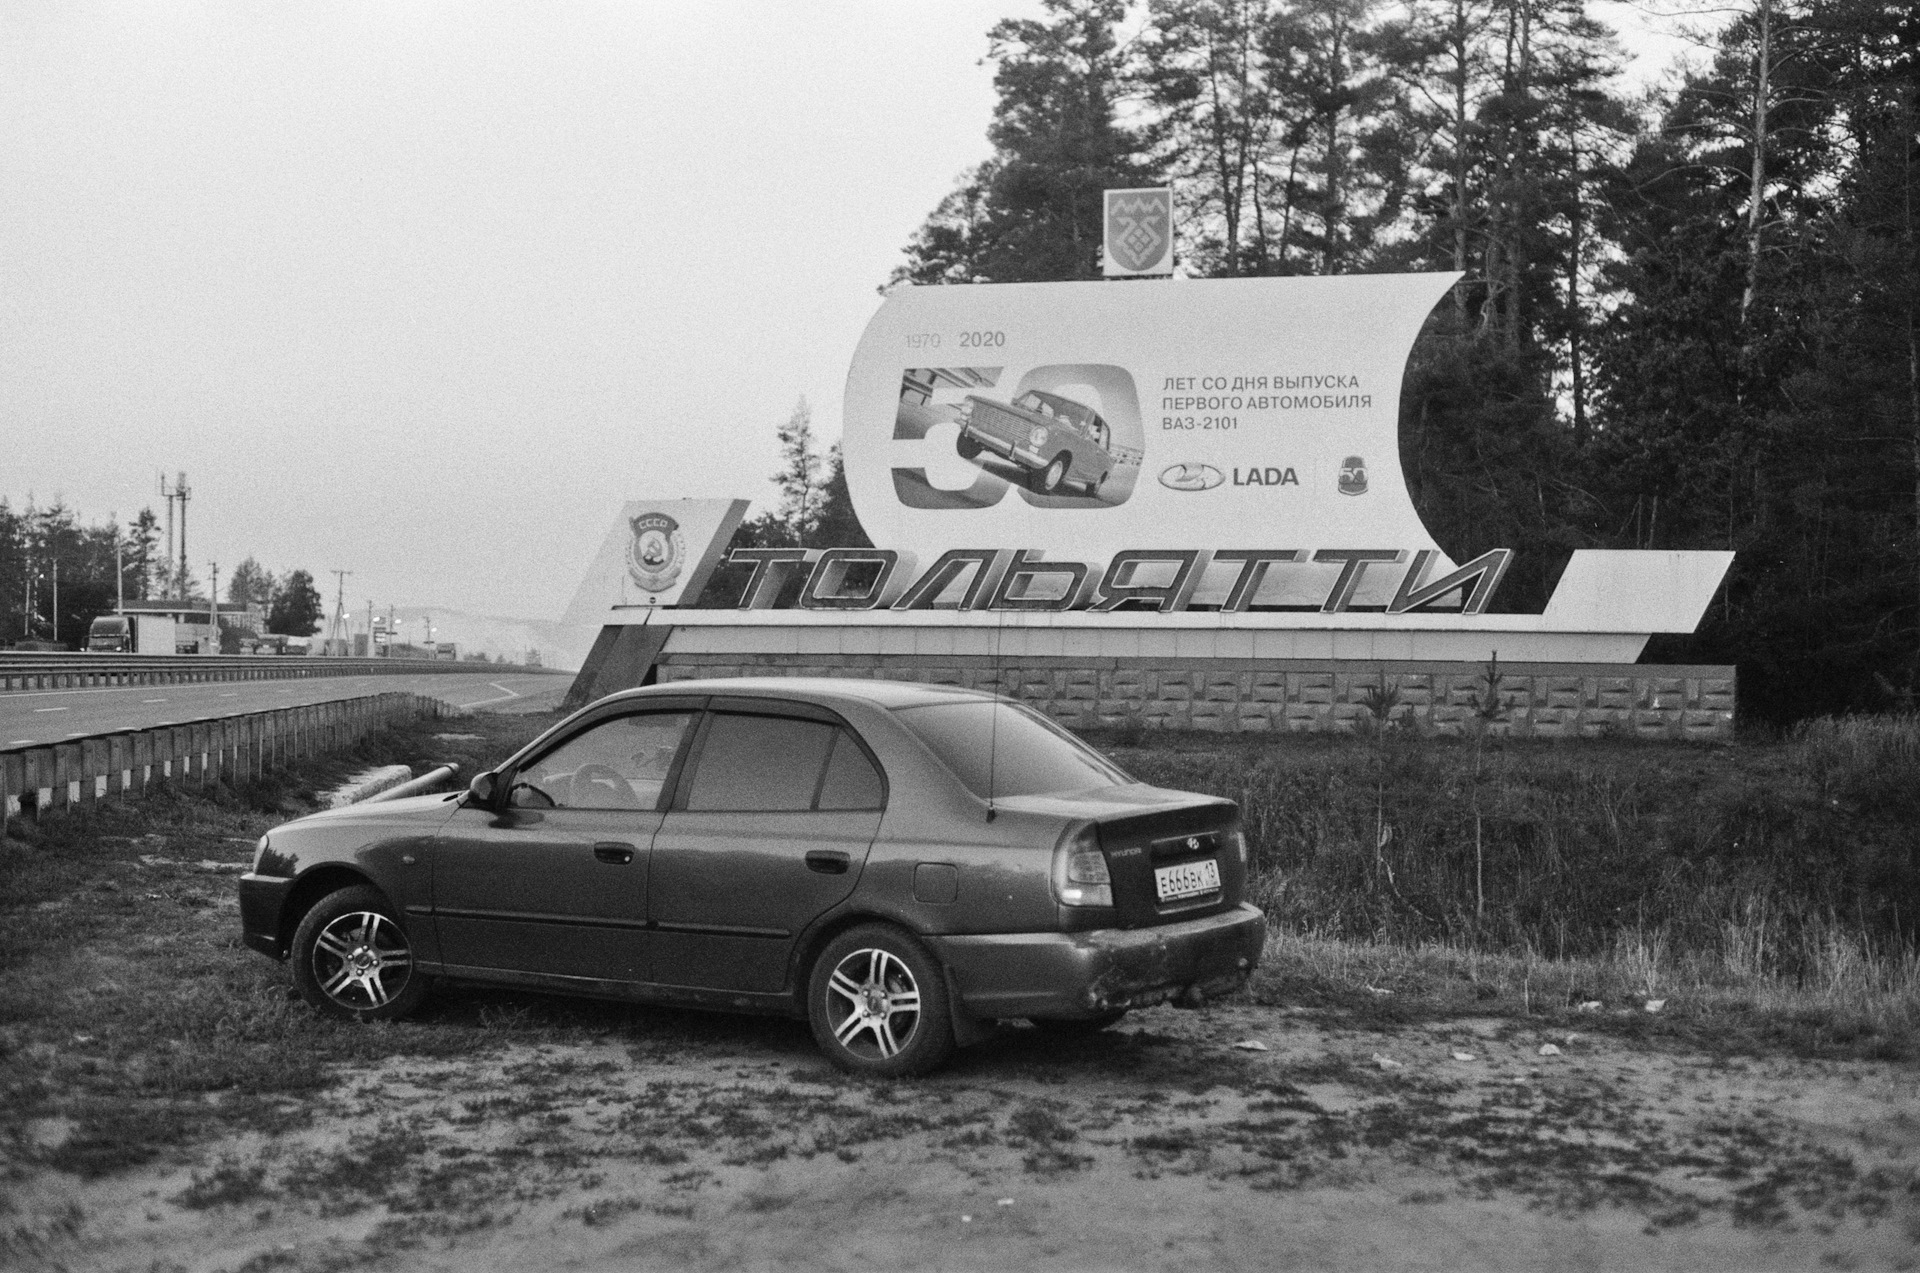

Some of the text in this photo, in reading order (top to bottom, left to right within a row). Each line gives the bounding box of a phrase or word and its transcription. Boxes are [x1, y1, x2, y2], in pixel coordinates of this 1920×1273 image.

[905, 331, 1006, 349] 1970 2020
[1163, 374, 1359, 392] ЛЕТ СО ДНЯ ВЫПУСКА
[1162, 394, 1372, 410] ПЕРВОГО АВТОМОБИЛЯ
[1162, 416, 1238, 430] ВАЗ-2101
[890, 363, 1146, 510] 50
[1233, 467, 1299, 486] LADA
[638, 518, 668, 530] СССР
[728, 547, 1515, 614] ТОЛЬЯТТИ
